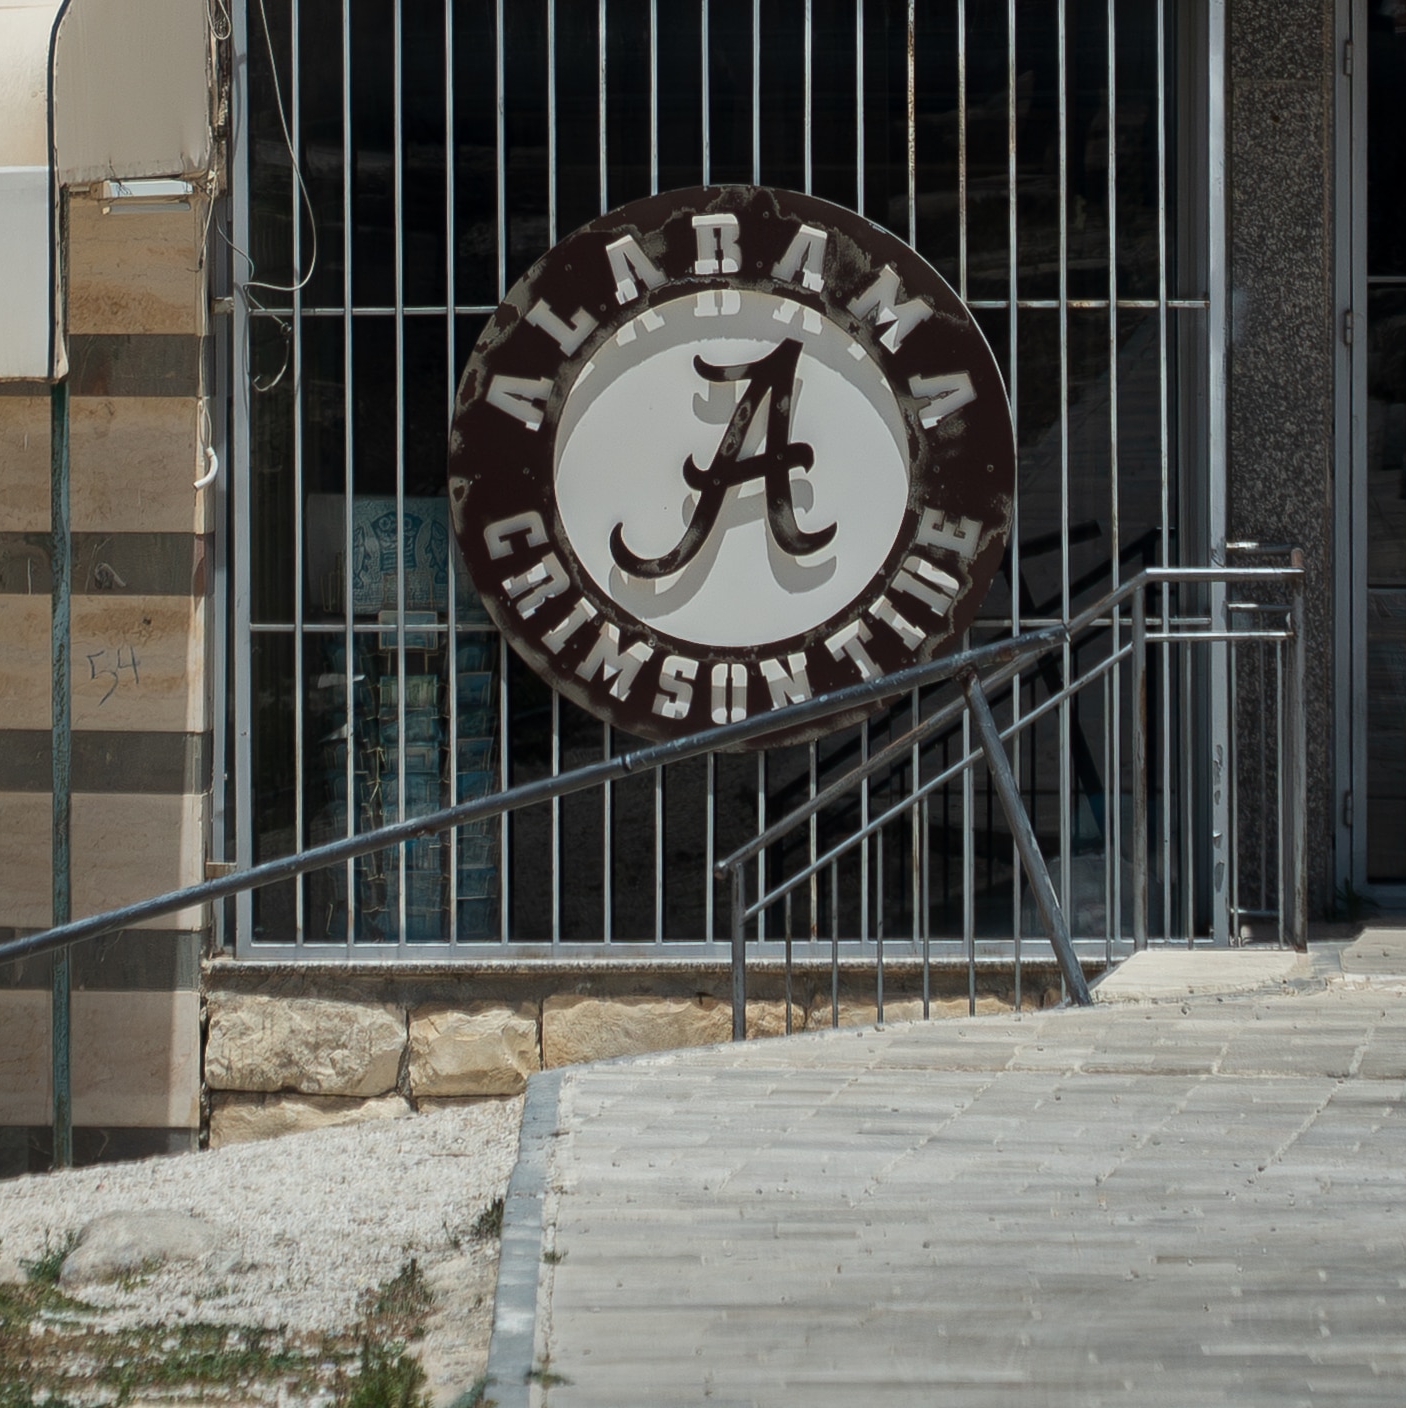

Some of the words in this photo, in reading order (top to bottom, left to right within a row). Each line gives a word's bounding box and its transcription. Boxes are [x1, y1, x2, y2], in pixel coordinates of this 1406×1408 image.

[485, 212, 978, 432] ALABAMA
[608, 337, 838, 579] A
[85, 645, 142, 706] 54
[483, 510, 815, 725] CRIMSON
[824, 506, 984, 687] TIDE
